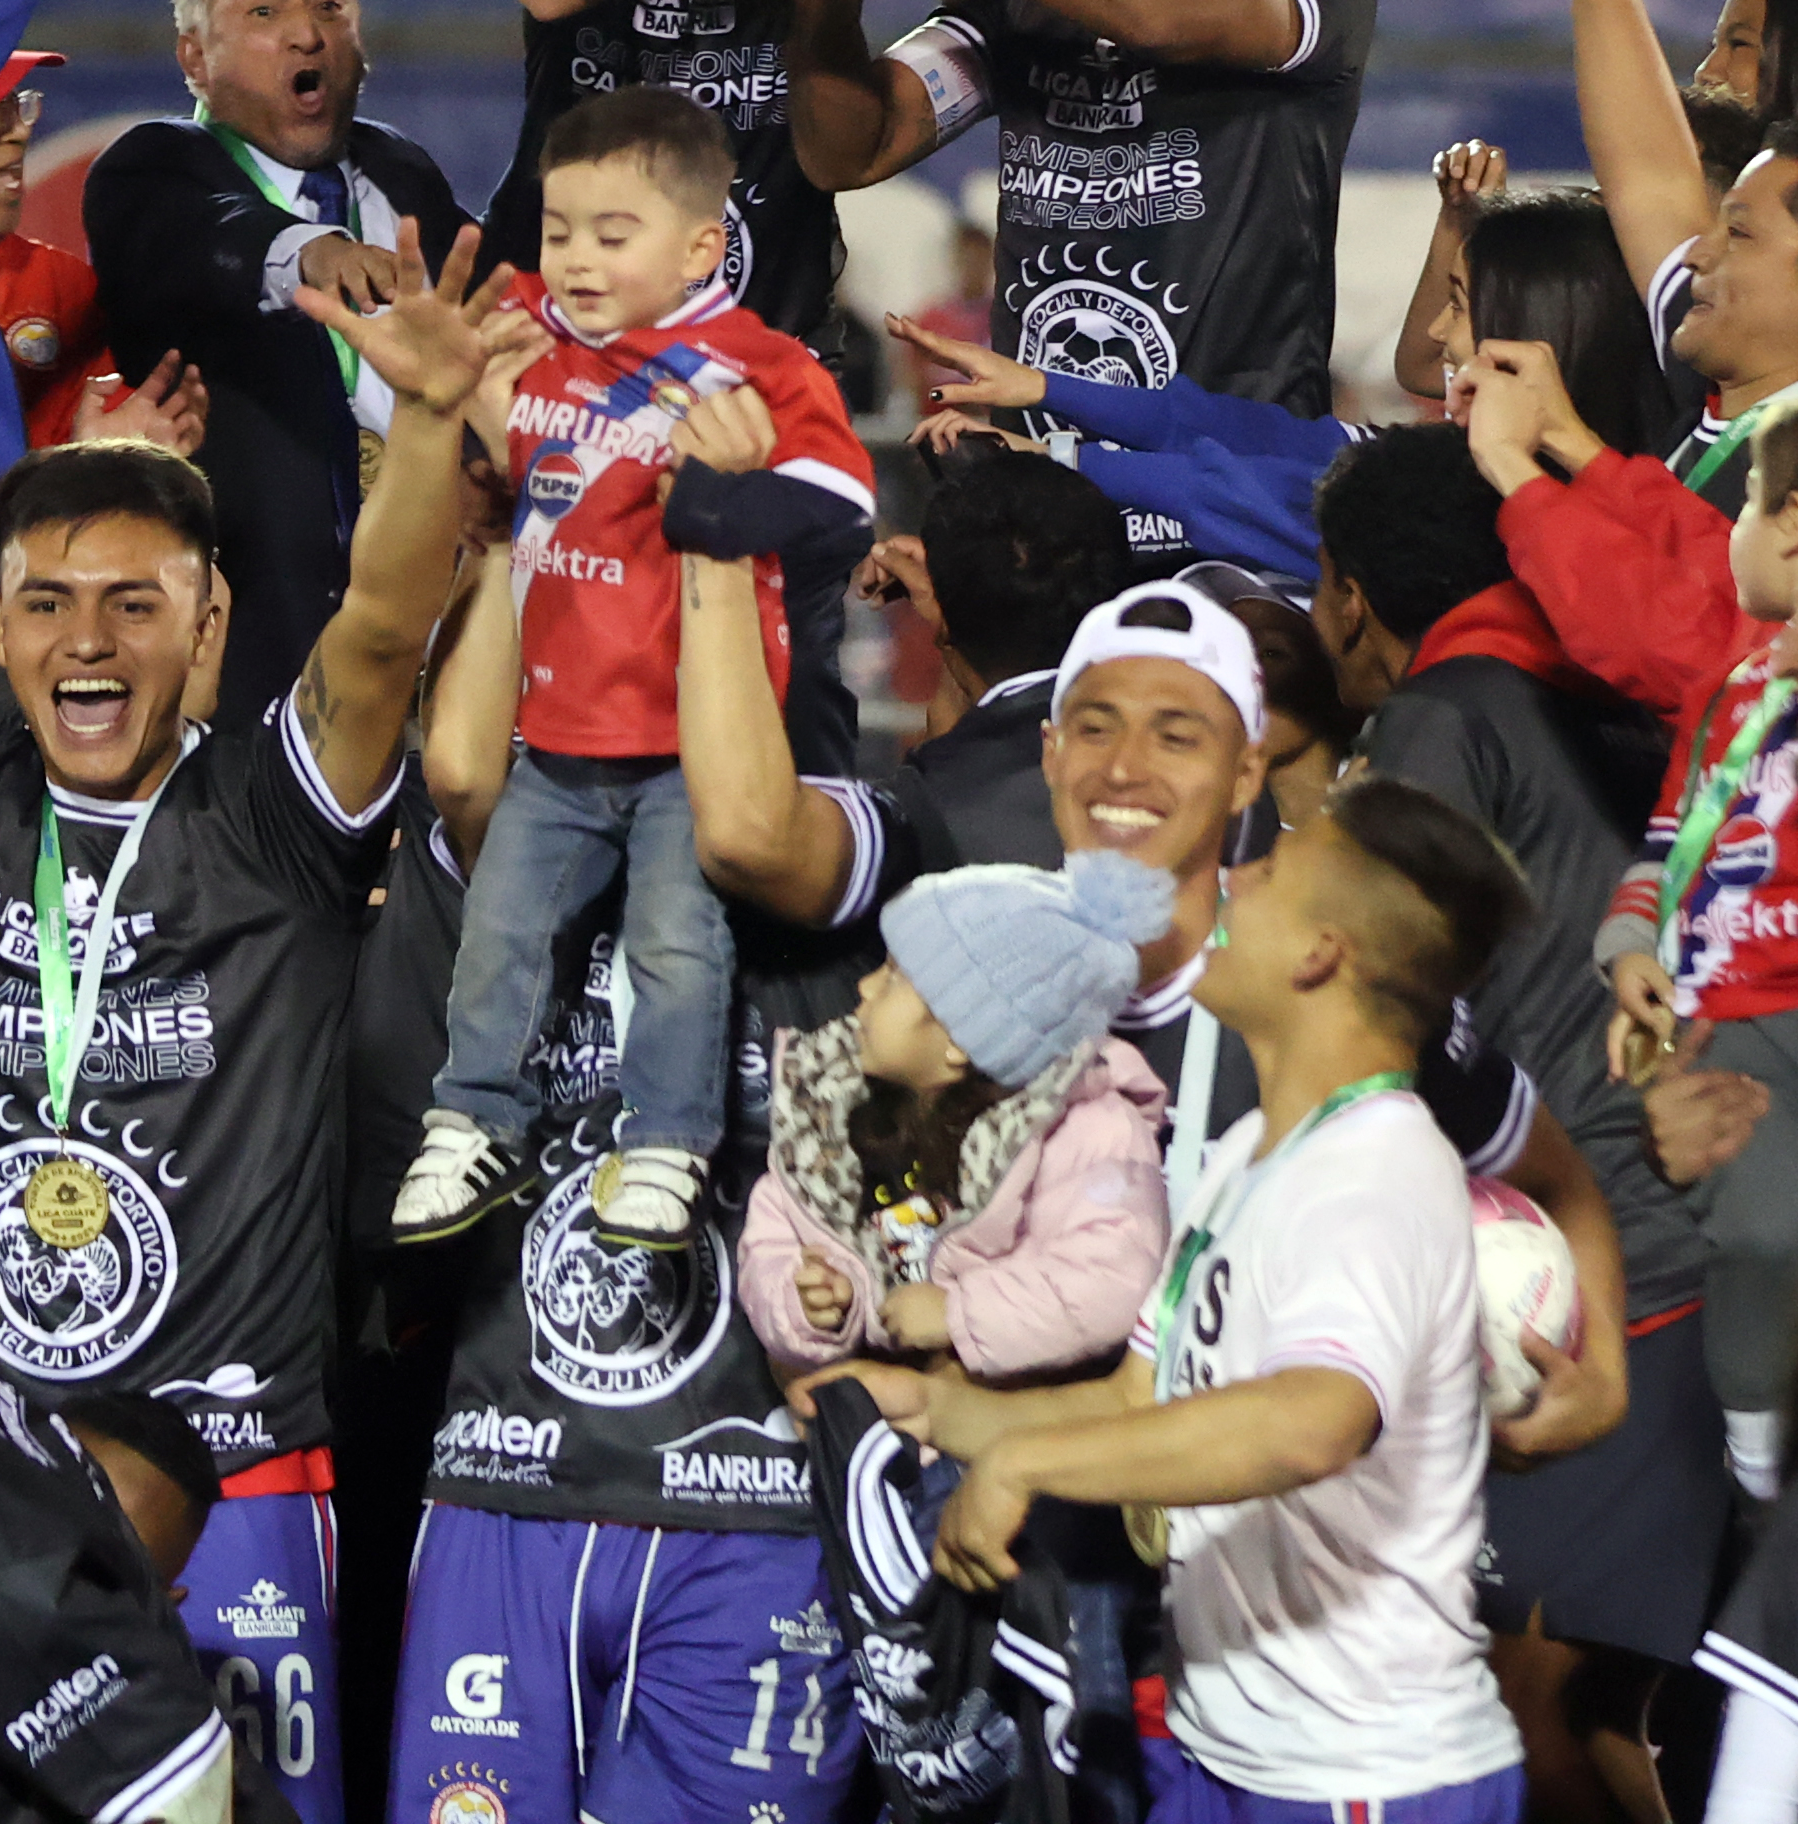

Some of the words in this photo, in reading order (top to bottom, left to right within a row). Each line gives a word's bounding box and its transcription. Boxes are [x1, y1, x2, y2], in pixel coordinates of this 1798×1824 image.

[1000, 158, 1203, 205] CAMPEONES
[1028, 291, 1081, 332] SOCIAL
[1081, 292, 1094, 308] Y
[1096, 296, 1169, 391] DEPORTIVO
[532, 474, 580, 499] PEPSI
[515, 536, 625, 586] elektra
[545, 1351, 636, 1392] XELAJU
[216, 1606, 257, 1623] LIGA
[259, 1605, 306, 1623] GUATE
[5, 1652, 121, 1753] molten
[444, 1652, 504, 1719] G
[430, 1714, 521, 1739] GATORADE
[730, 1656, 827, 1777] 14
